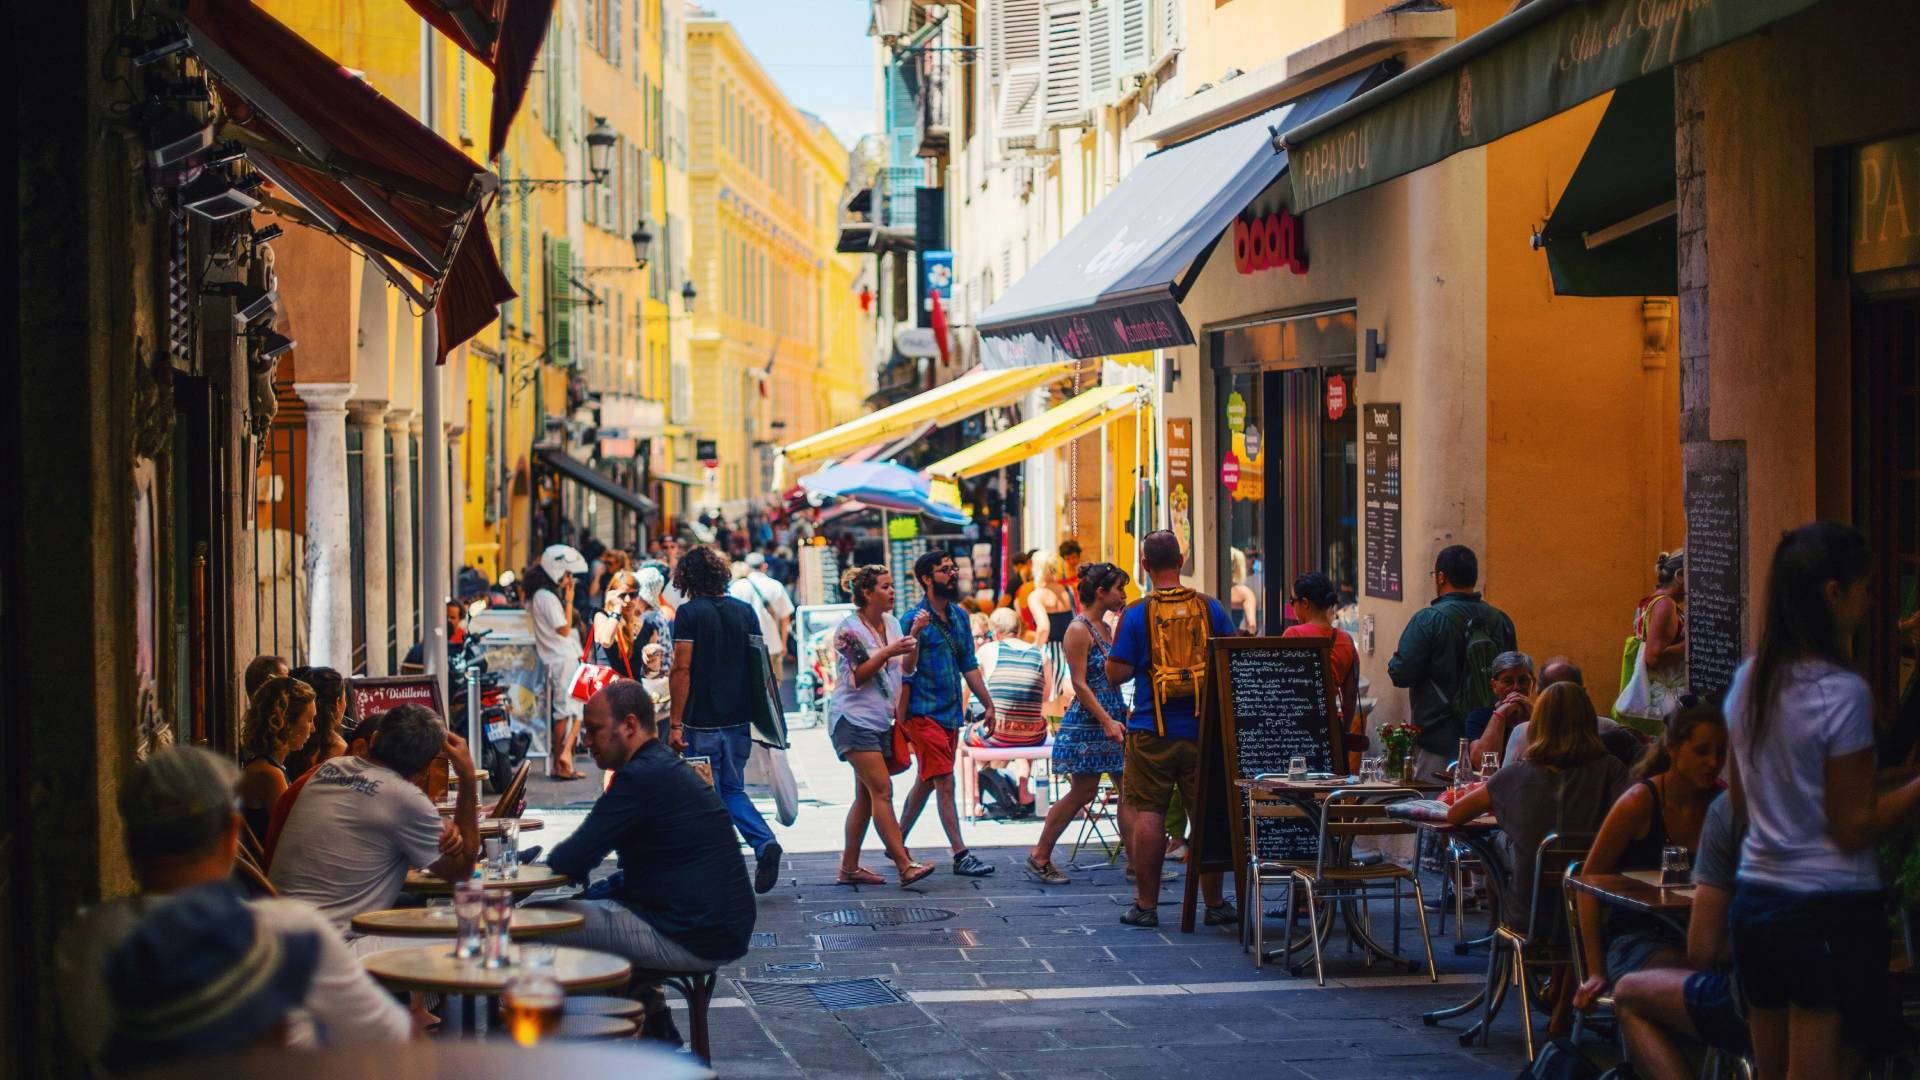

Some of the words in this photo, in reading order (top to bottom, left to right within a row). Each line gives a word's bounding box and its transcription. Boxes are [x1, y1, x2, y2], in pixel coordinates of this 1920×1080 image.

[1303, 126, 1370, 192] PAPAYOU
[386, 686, 431, 699] Distilleries
[1265, 718, 1293, 728] PLATS
